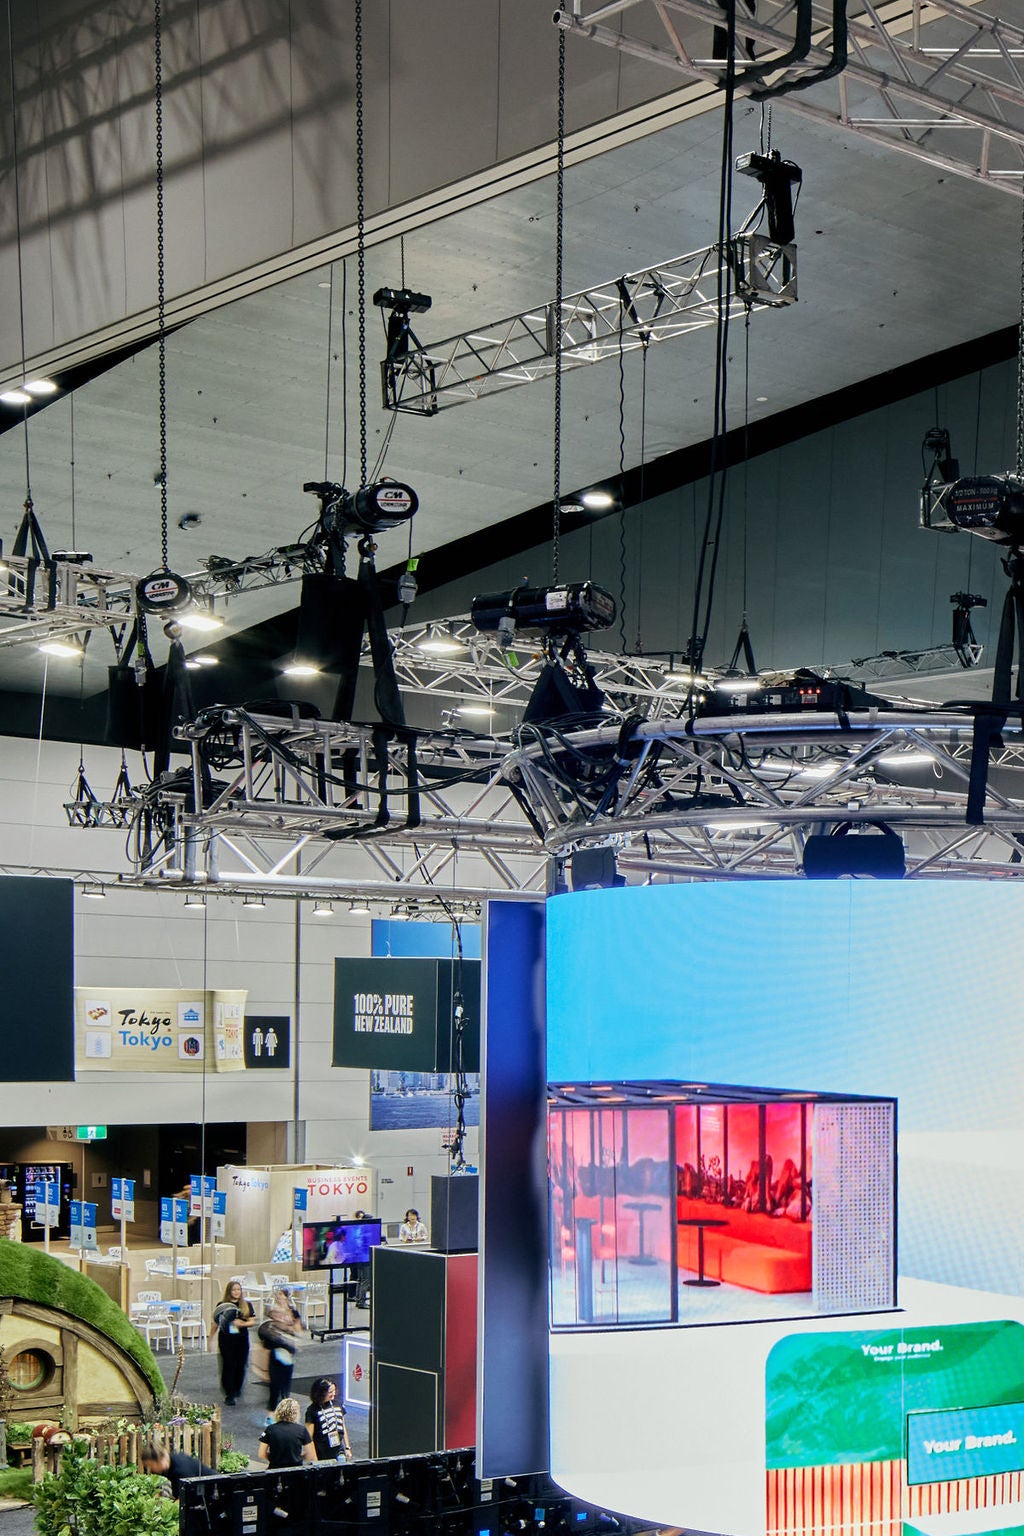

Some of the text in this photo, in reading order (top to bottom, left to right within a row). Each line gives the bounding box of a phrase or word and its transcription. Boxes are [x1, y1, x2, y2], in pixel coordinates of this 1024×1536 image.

[956, 502, 994, 511] MAXIMUM
[151, 581, 170, 590] CM
[354, 993, 414, 1016] 100% PURE
[118, 1009, 172, 1034] Tokyo
[354, 1015, 413, 1034] NEW ZEALAND
[118, 1031, 173, 1050] Tokyo
[307, 1182, 368, 1196] TOKYO
[861, 1339, 944, 1356] Your Brand.
[923, 1429, 1017, 1454] Your Brand.
